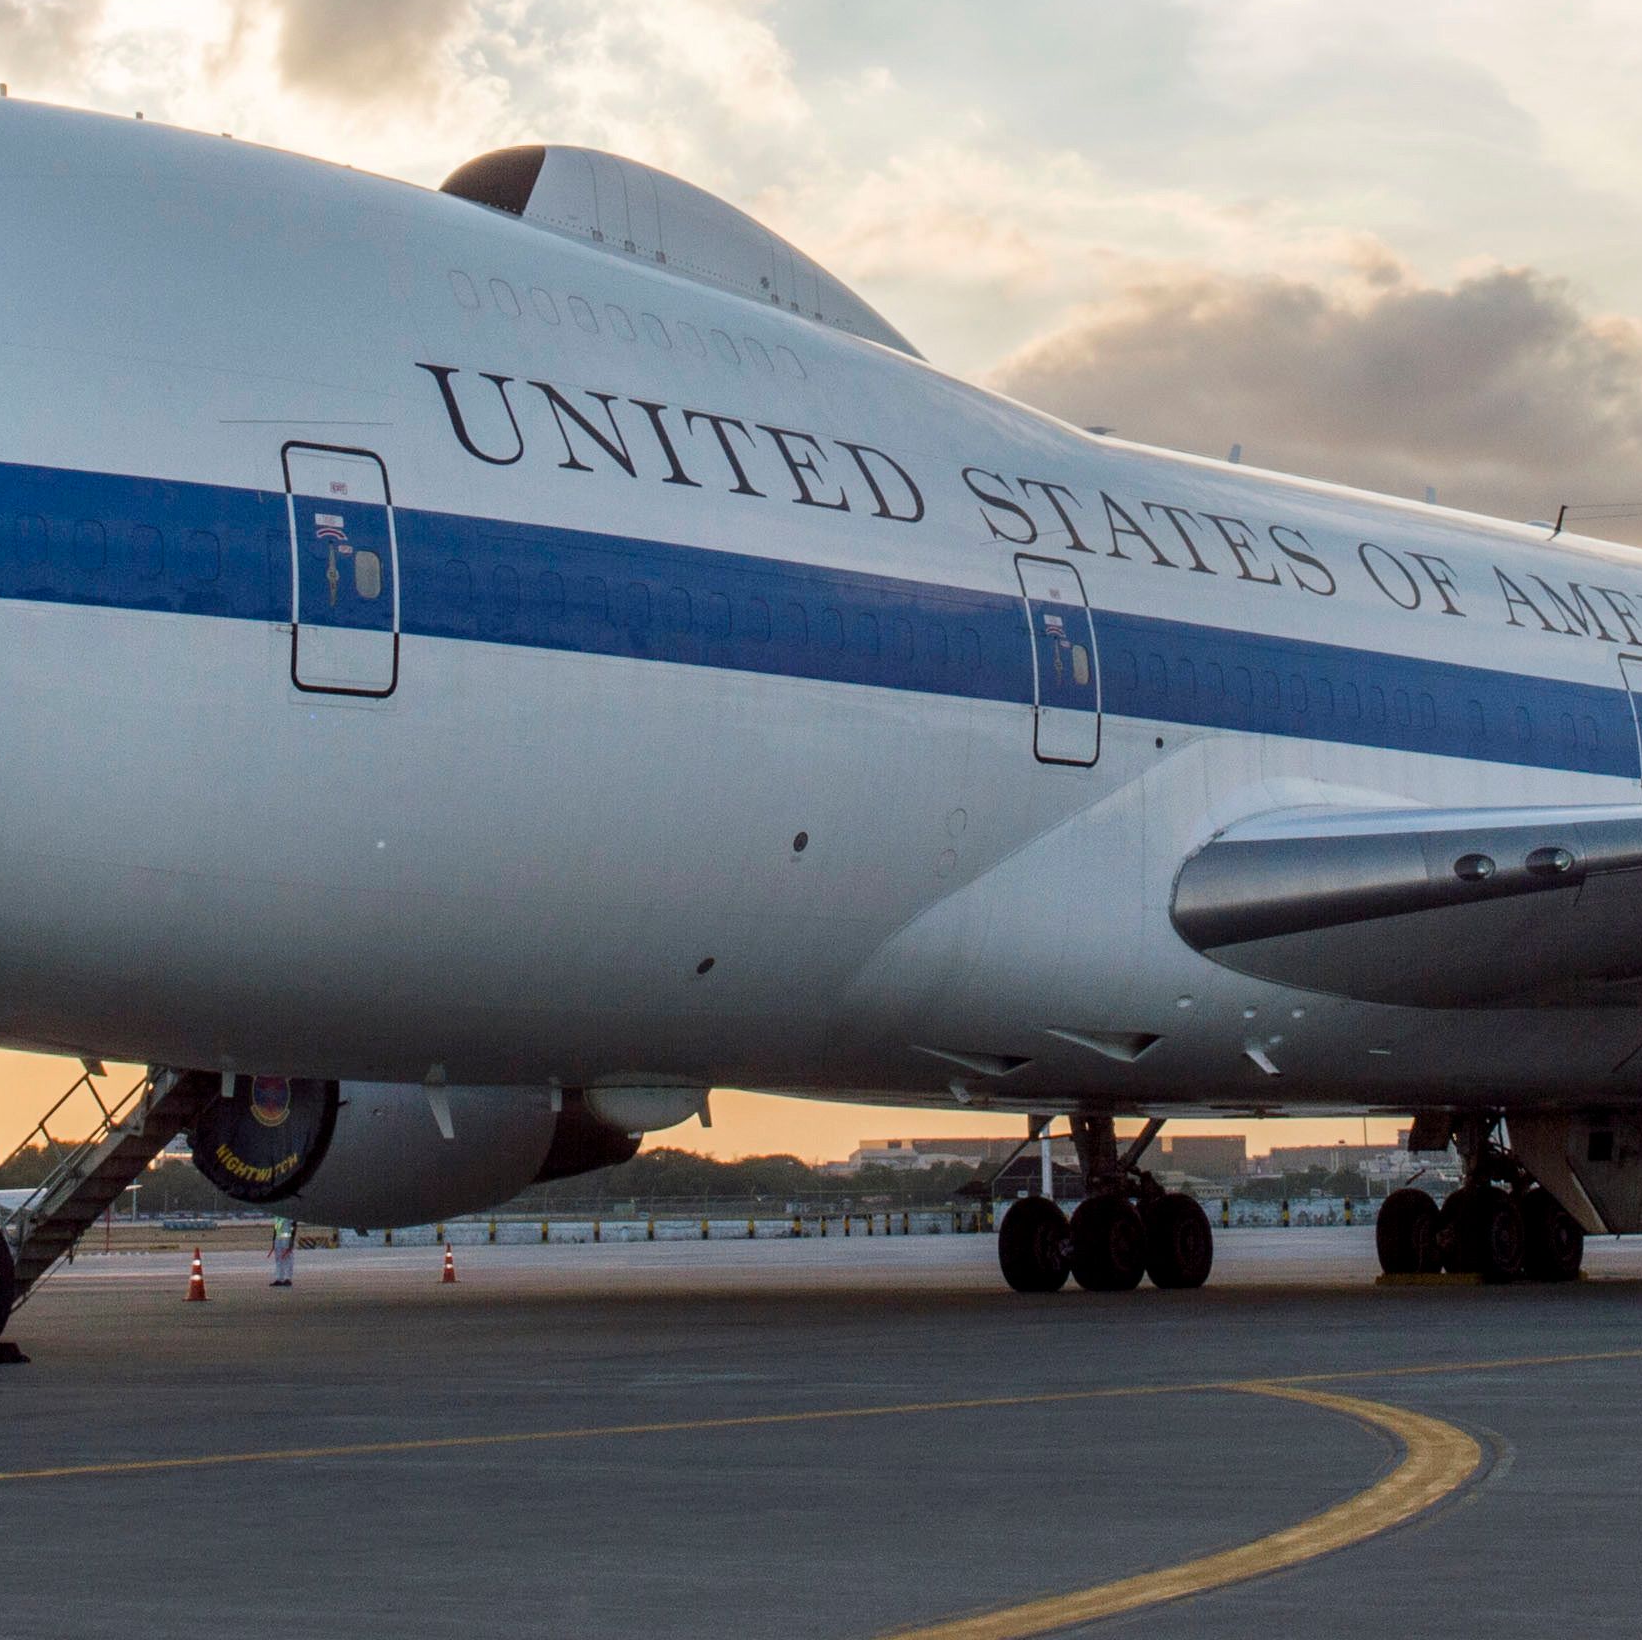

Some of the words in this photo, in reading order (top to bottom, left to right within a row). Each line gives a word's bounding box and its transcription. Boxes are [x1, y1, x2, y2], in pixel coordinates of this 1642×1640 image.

[414, 362, 925, 524] UNITED
[961, 466, 1337, 596] STATES
[1357, 542, 1467, 618] OF
